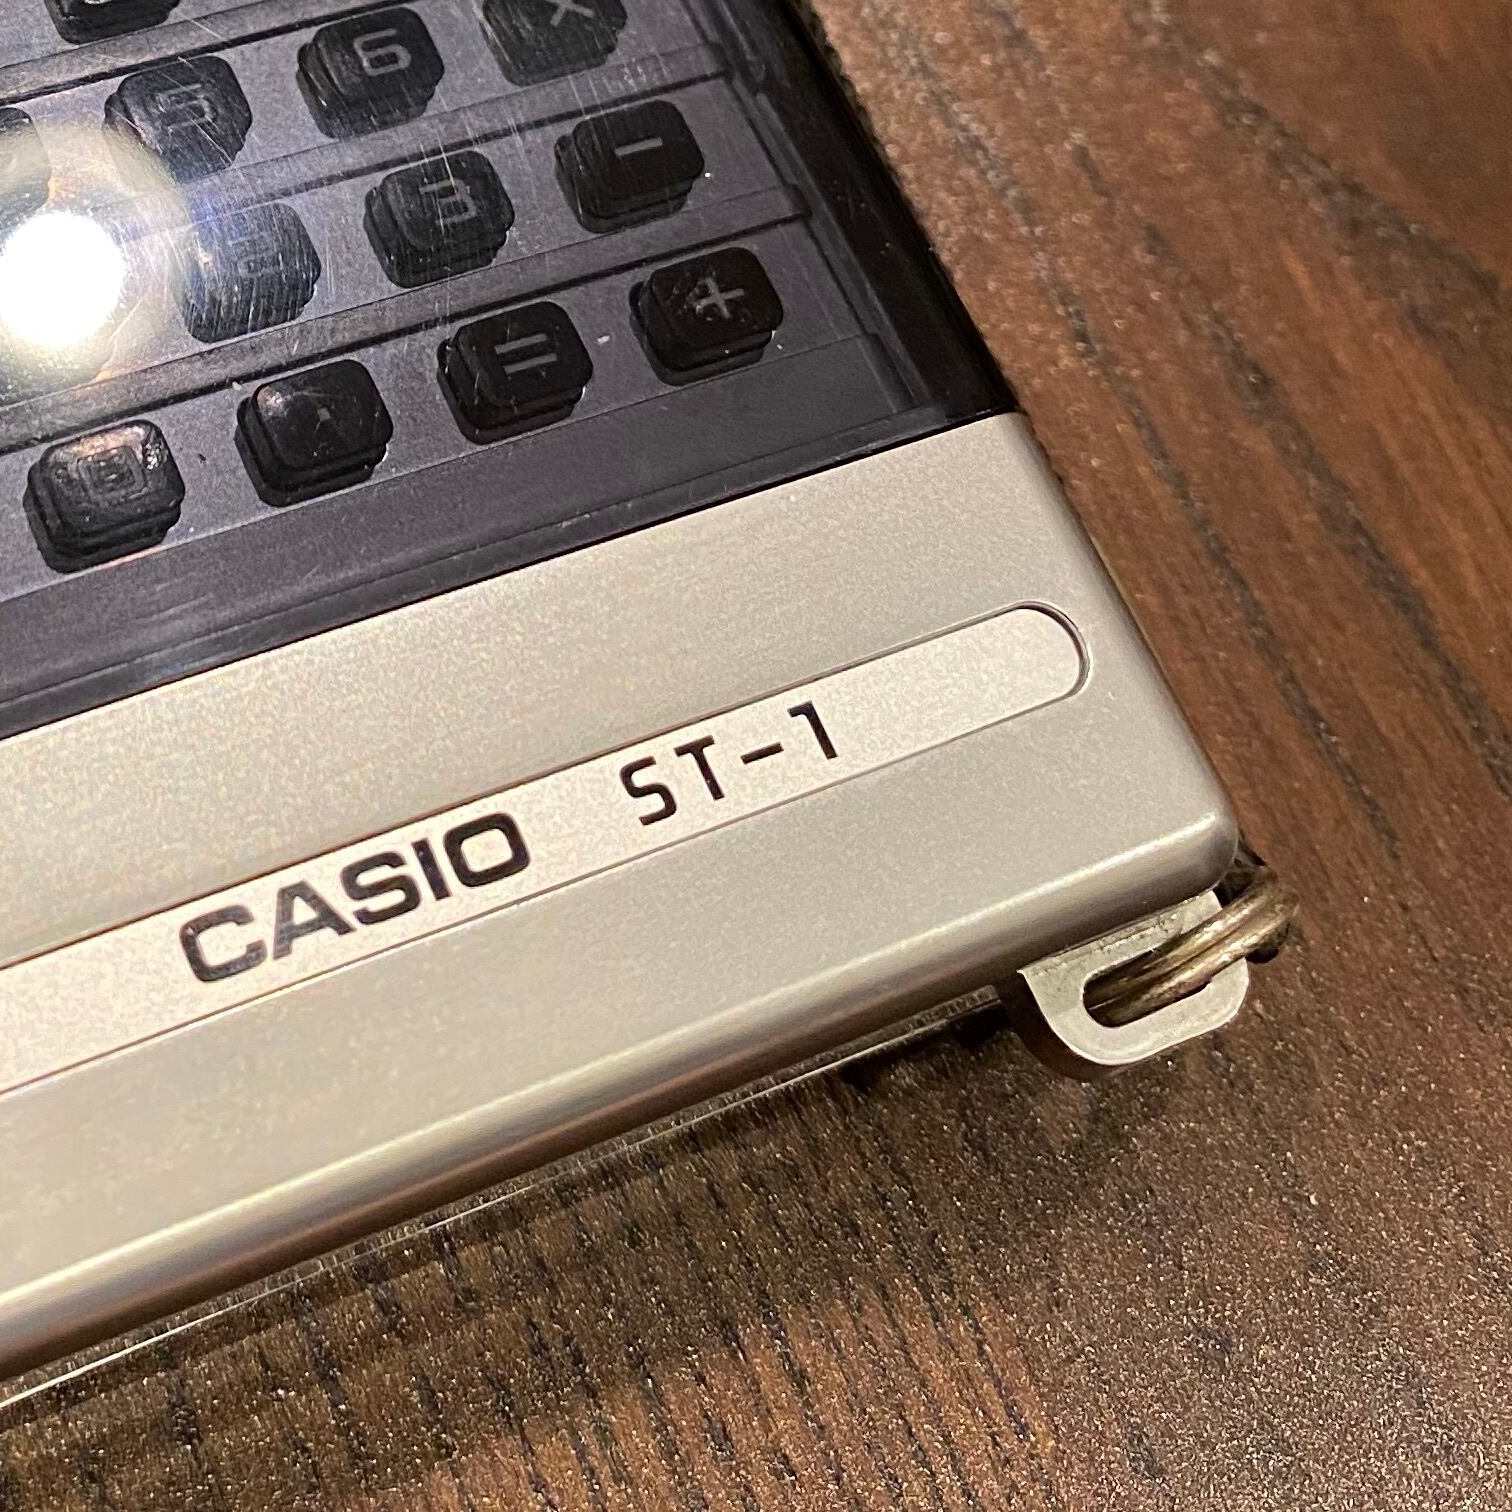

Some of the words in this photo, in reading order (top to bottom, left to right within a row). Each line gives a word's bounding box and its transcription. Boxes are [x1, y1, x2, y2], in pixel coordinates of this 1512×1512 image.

[352, 28, 412, 78] 6
[418, 178, 478, 224] 3
[178, 811, 531, 983] CASIO
[619, 700, 839, 826] ST-1
